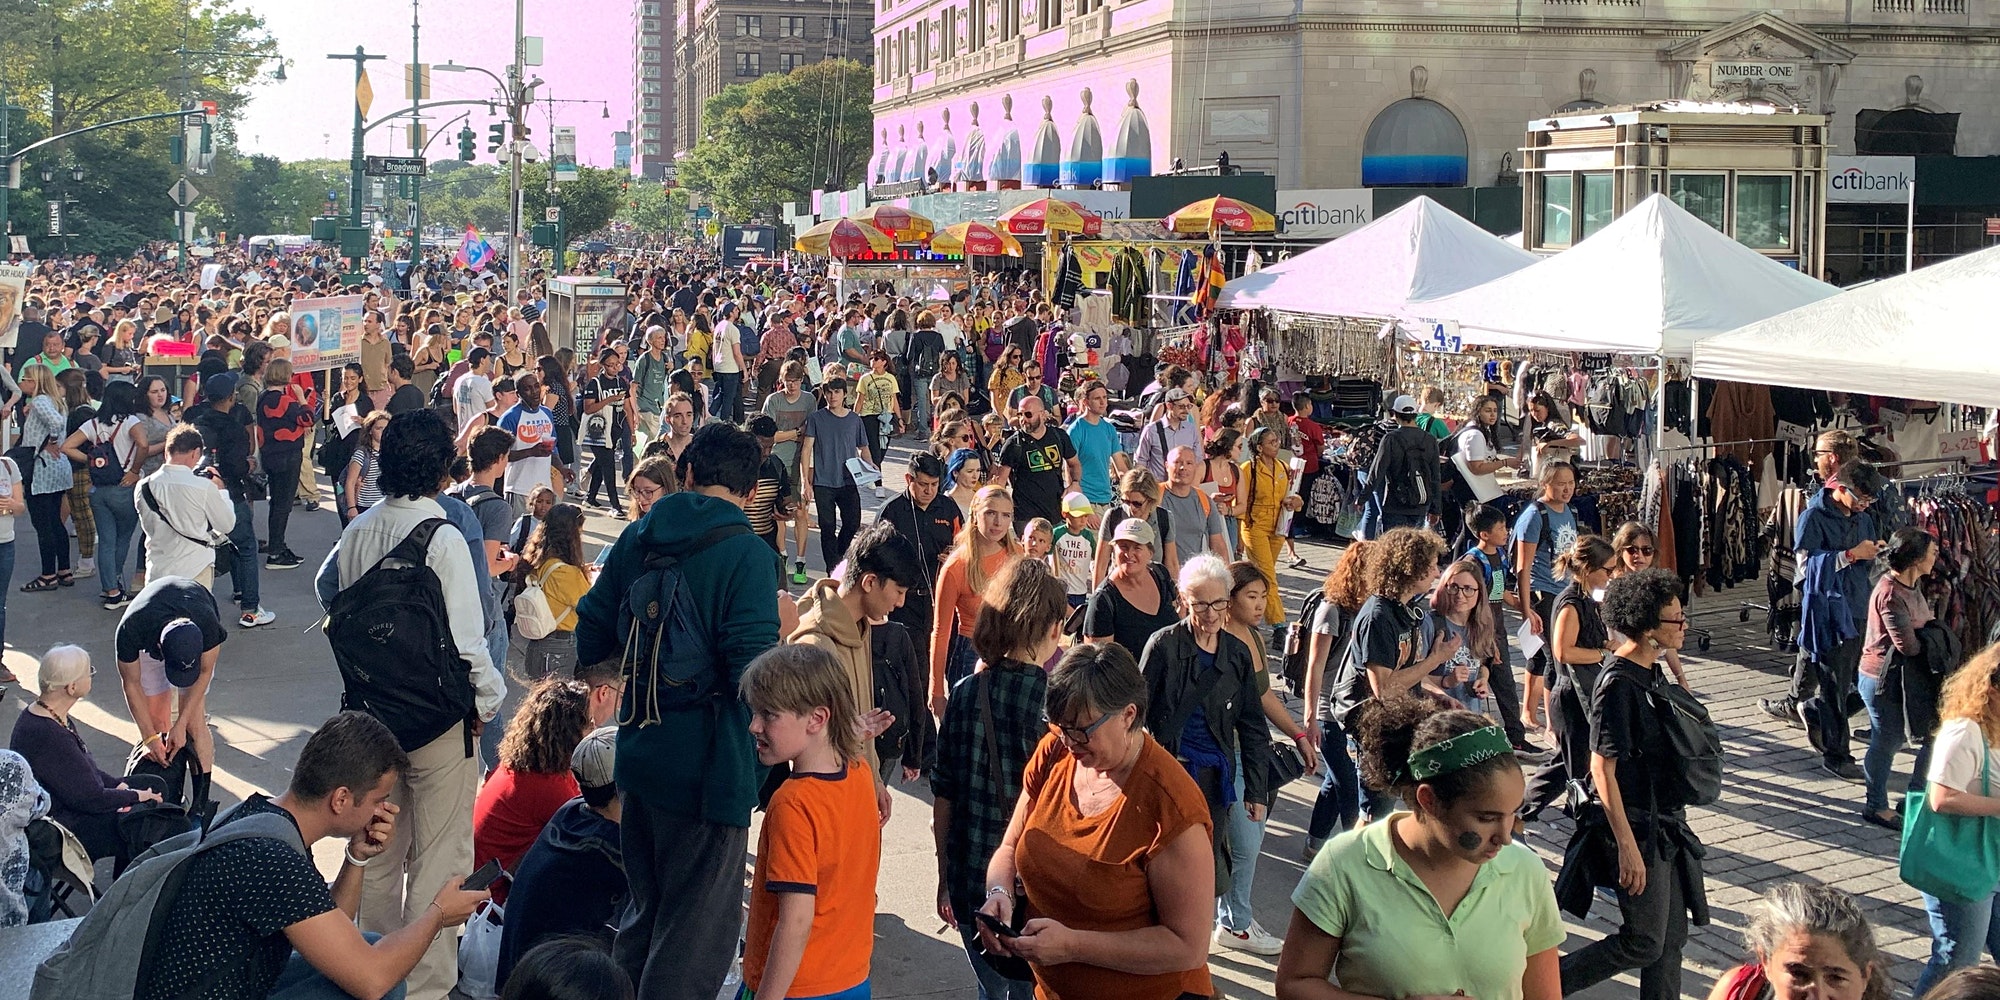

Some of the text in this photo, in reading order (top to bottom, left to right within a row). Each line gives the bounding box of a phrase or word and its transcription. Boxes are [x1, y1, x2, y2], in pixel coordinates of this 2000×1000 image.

[1717, 65, 1792, 76] NUMBER ONE
[386, 162, 421, 172] Broadway
[1832, 170, 1909, 190] citibank
[50, 204, 59, 235] BATTERY
[1282, 203, 1366, 224] citibank
[1015, 221, 1039, 231] Coca-Cola
[741, 231, 760, 244] M
[972, 243, 996, 253] Coca-Cola
[576, 314, 603, 327] WHEN
[576, 327, 599, 339] THEY
[576, 340, 592, 352] SEE
[1424, 340, 1431, 351] 2
[576, 352, 588, 365] US
[1585, 359, 1607, 369] CITY
[1066, 541, 1081, 549] THE
[1059, 547, 1087, 558] FUTURE
[368, 622, 394, 634] OSPREY
